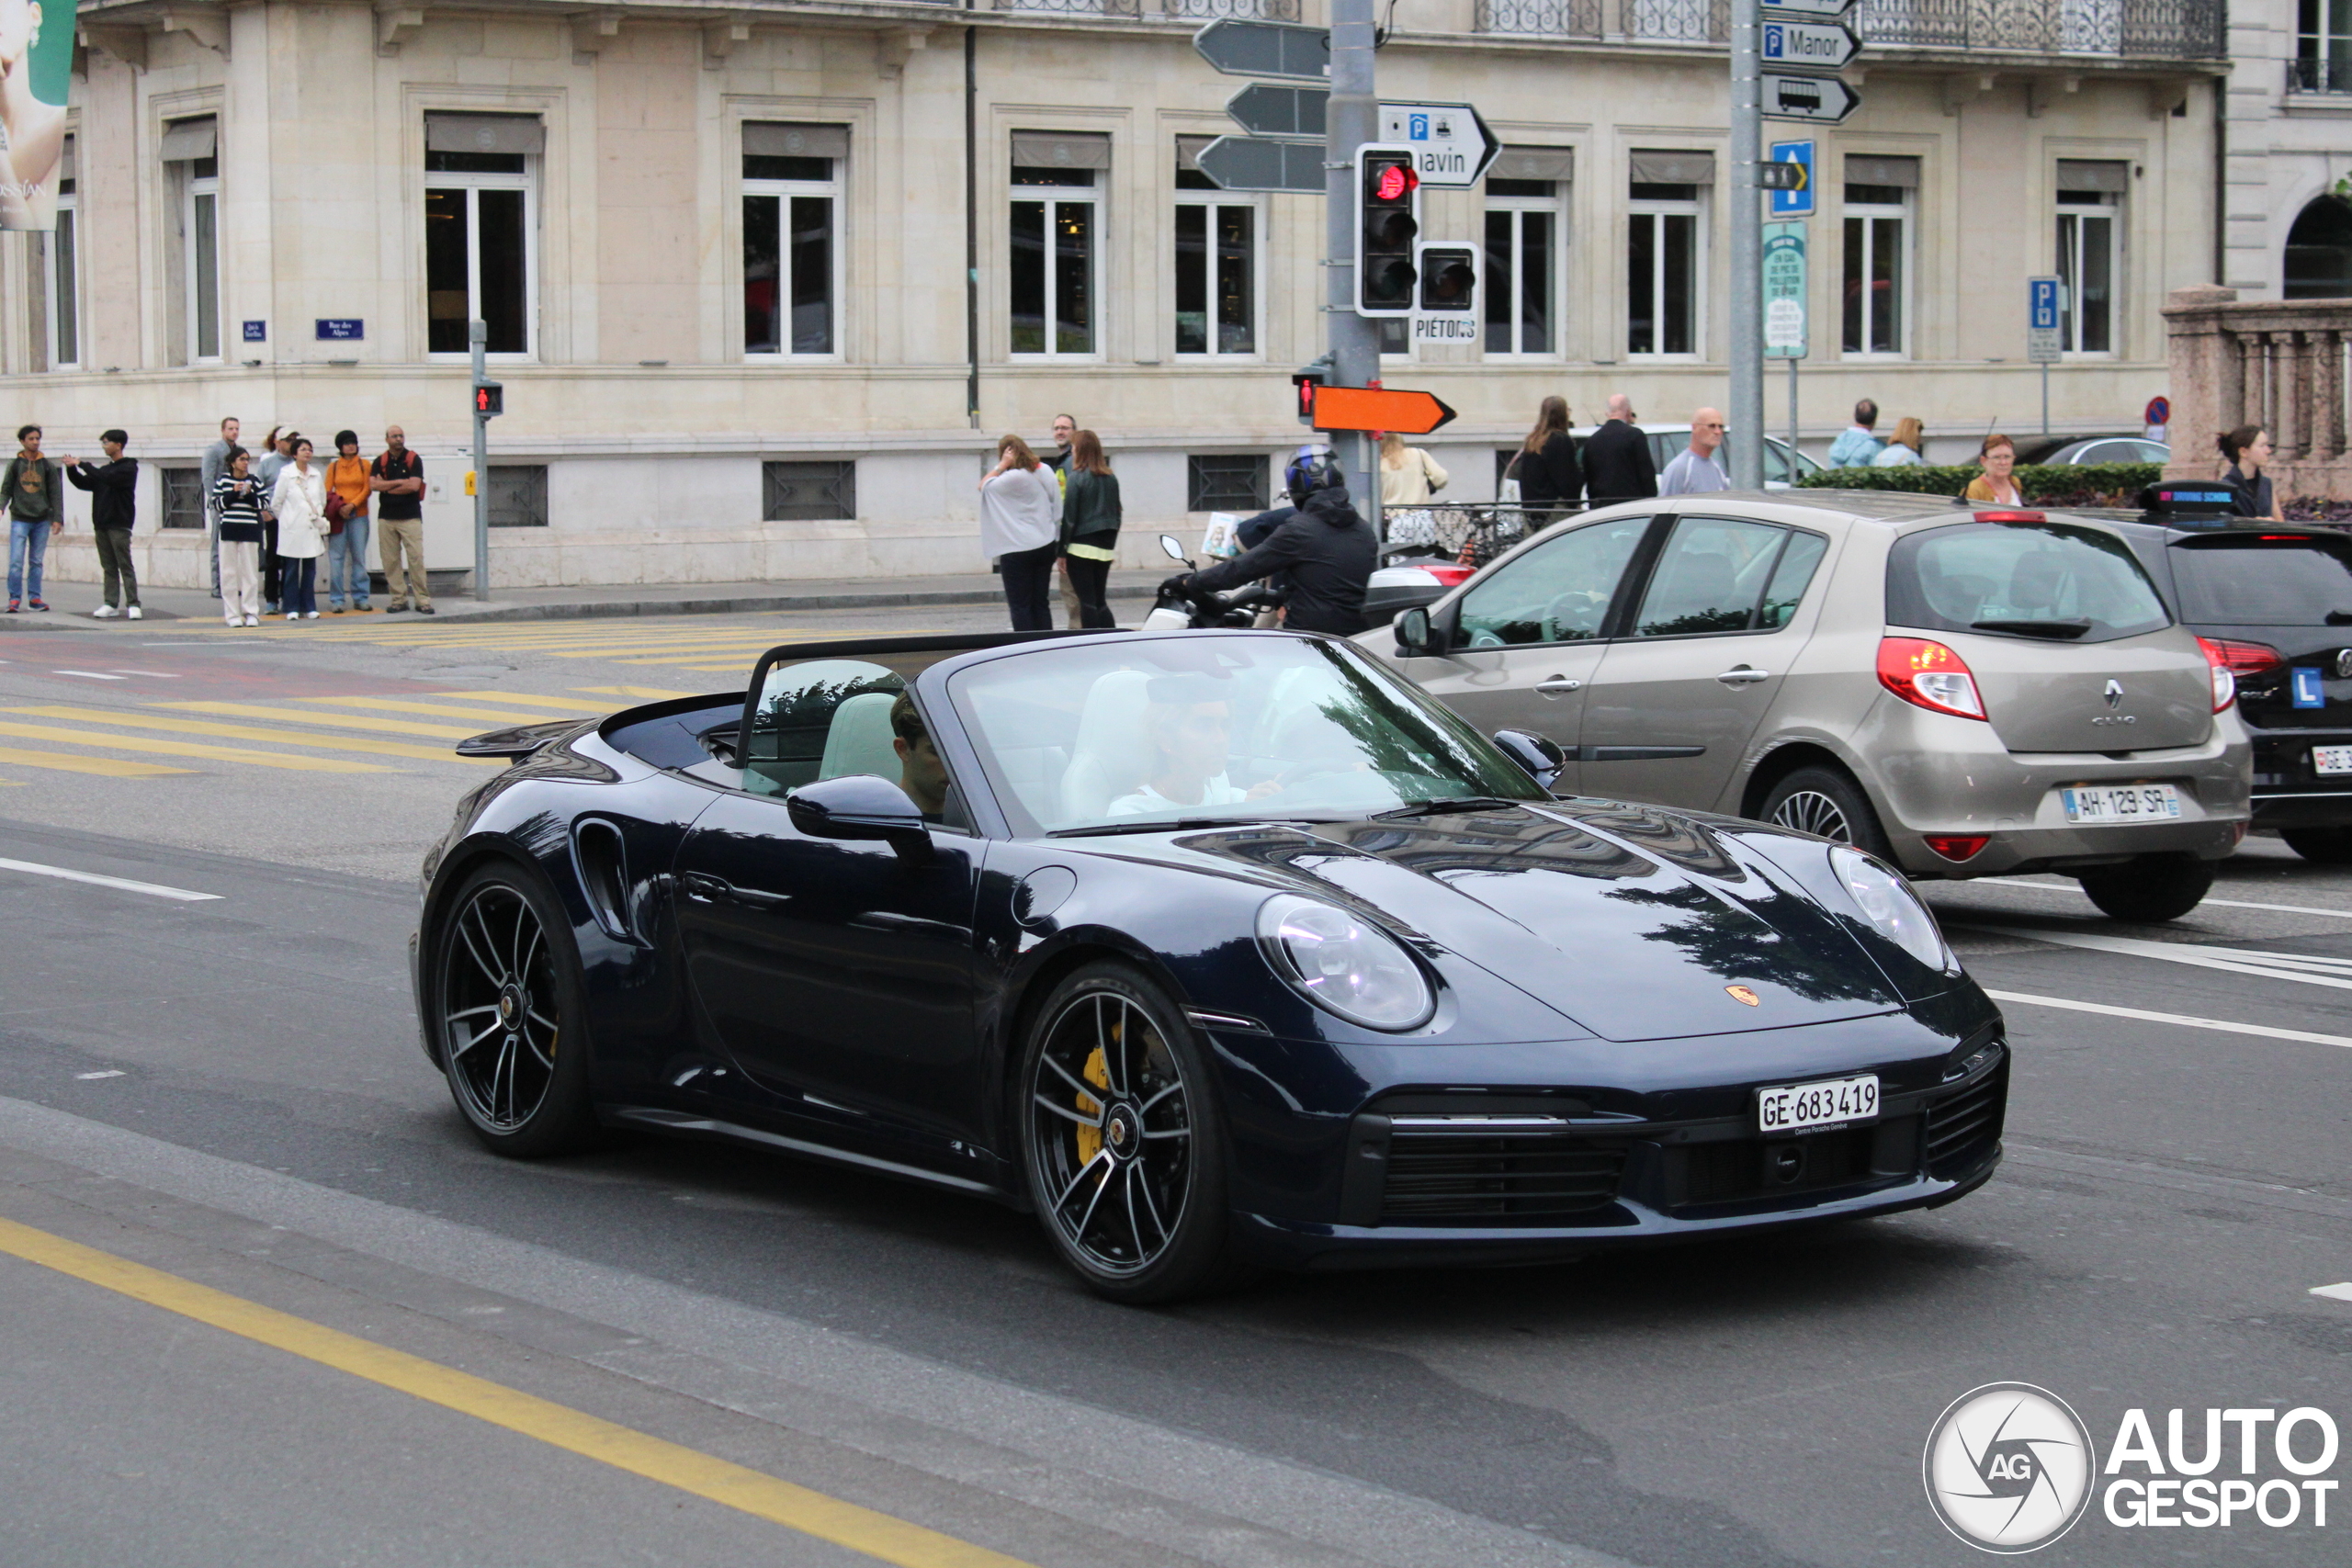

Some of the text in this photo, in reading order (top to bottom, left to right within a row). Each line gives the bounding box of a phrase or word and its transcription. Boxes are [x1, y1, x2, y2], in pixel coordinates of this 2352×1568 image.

[1789, 29, 1838, 56] Manor
[332, 329, 349, 337] Alpes
[2173, 491, 2202, 502] DRIVING
[2204, 491, 2233, 502] SCHOOL
[2298, 673, 2316, 702] L
[2092, 716, 2136, 726] CLIO
[1830, 1122, 1848, 1131] Genève
